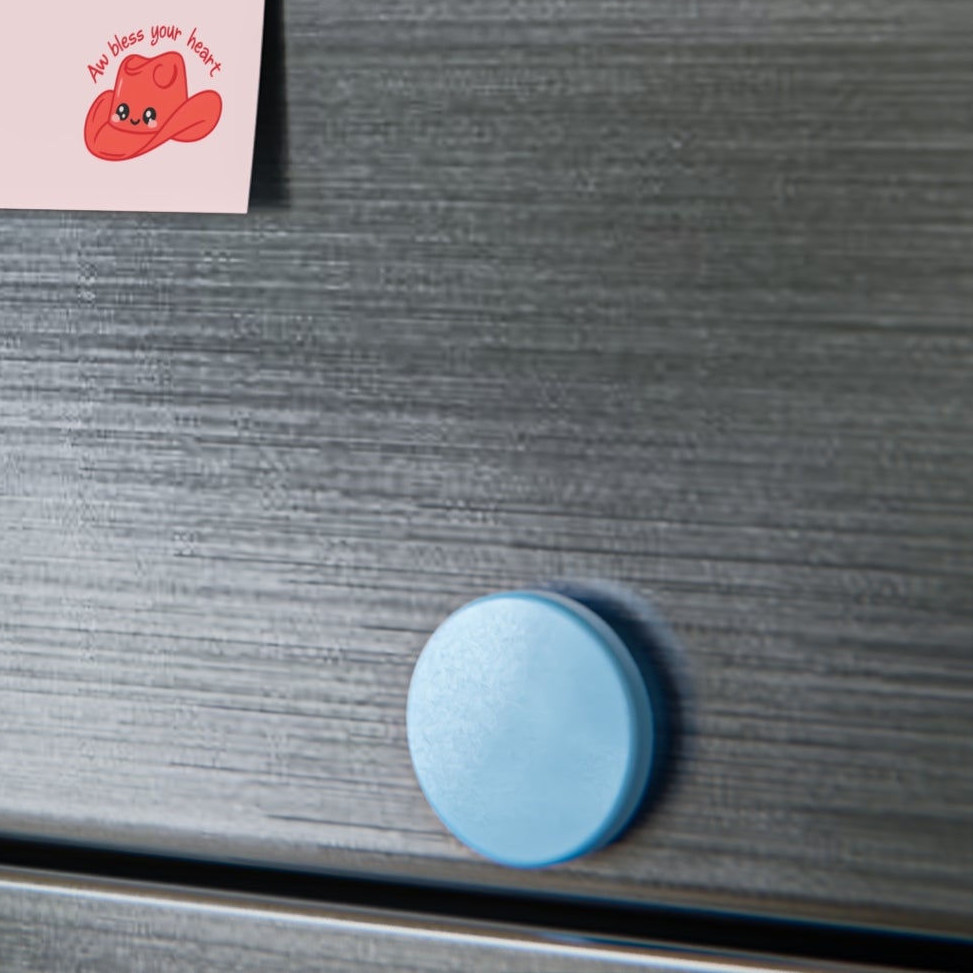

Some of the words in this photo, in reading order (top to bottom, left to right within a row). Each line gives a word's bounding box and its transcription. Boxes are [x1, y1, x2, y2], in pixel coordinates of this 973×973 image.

[87, 54, 109, 83] Aw
[107, 29, 144, 57] bless
[150, 25, 182, 46] your
[187, 28, 222, 77] heart
